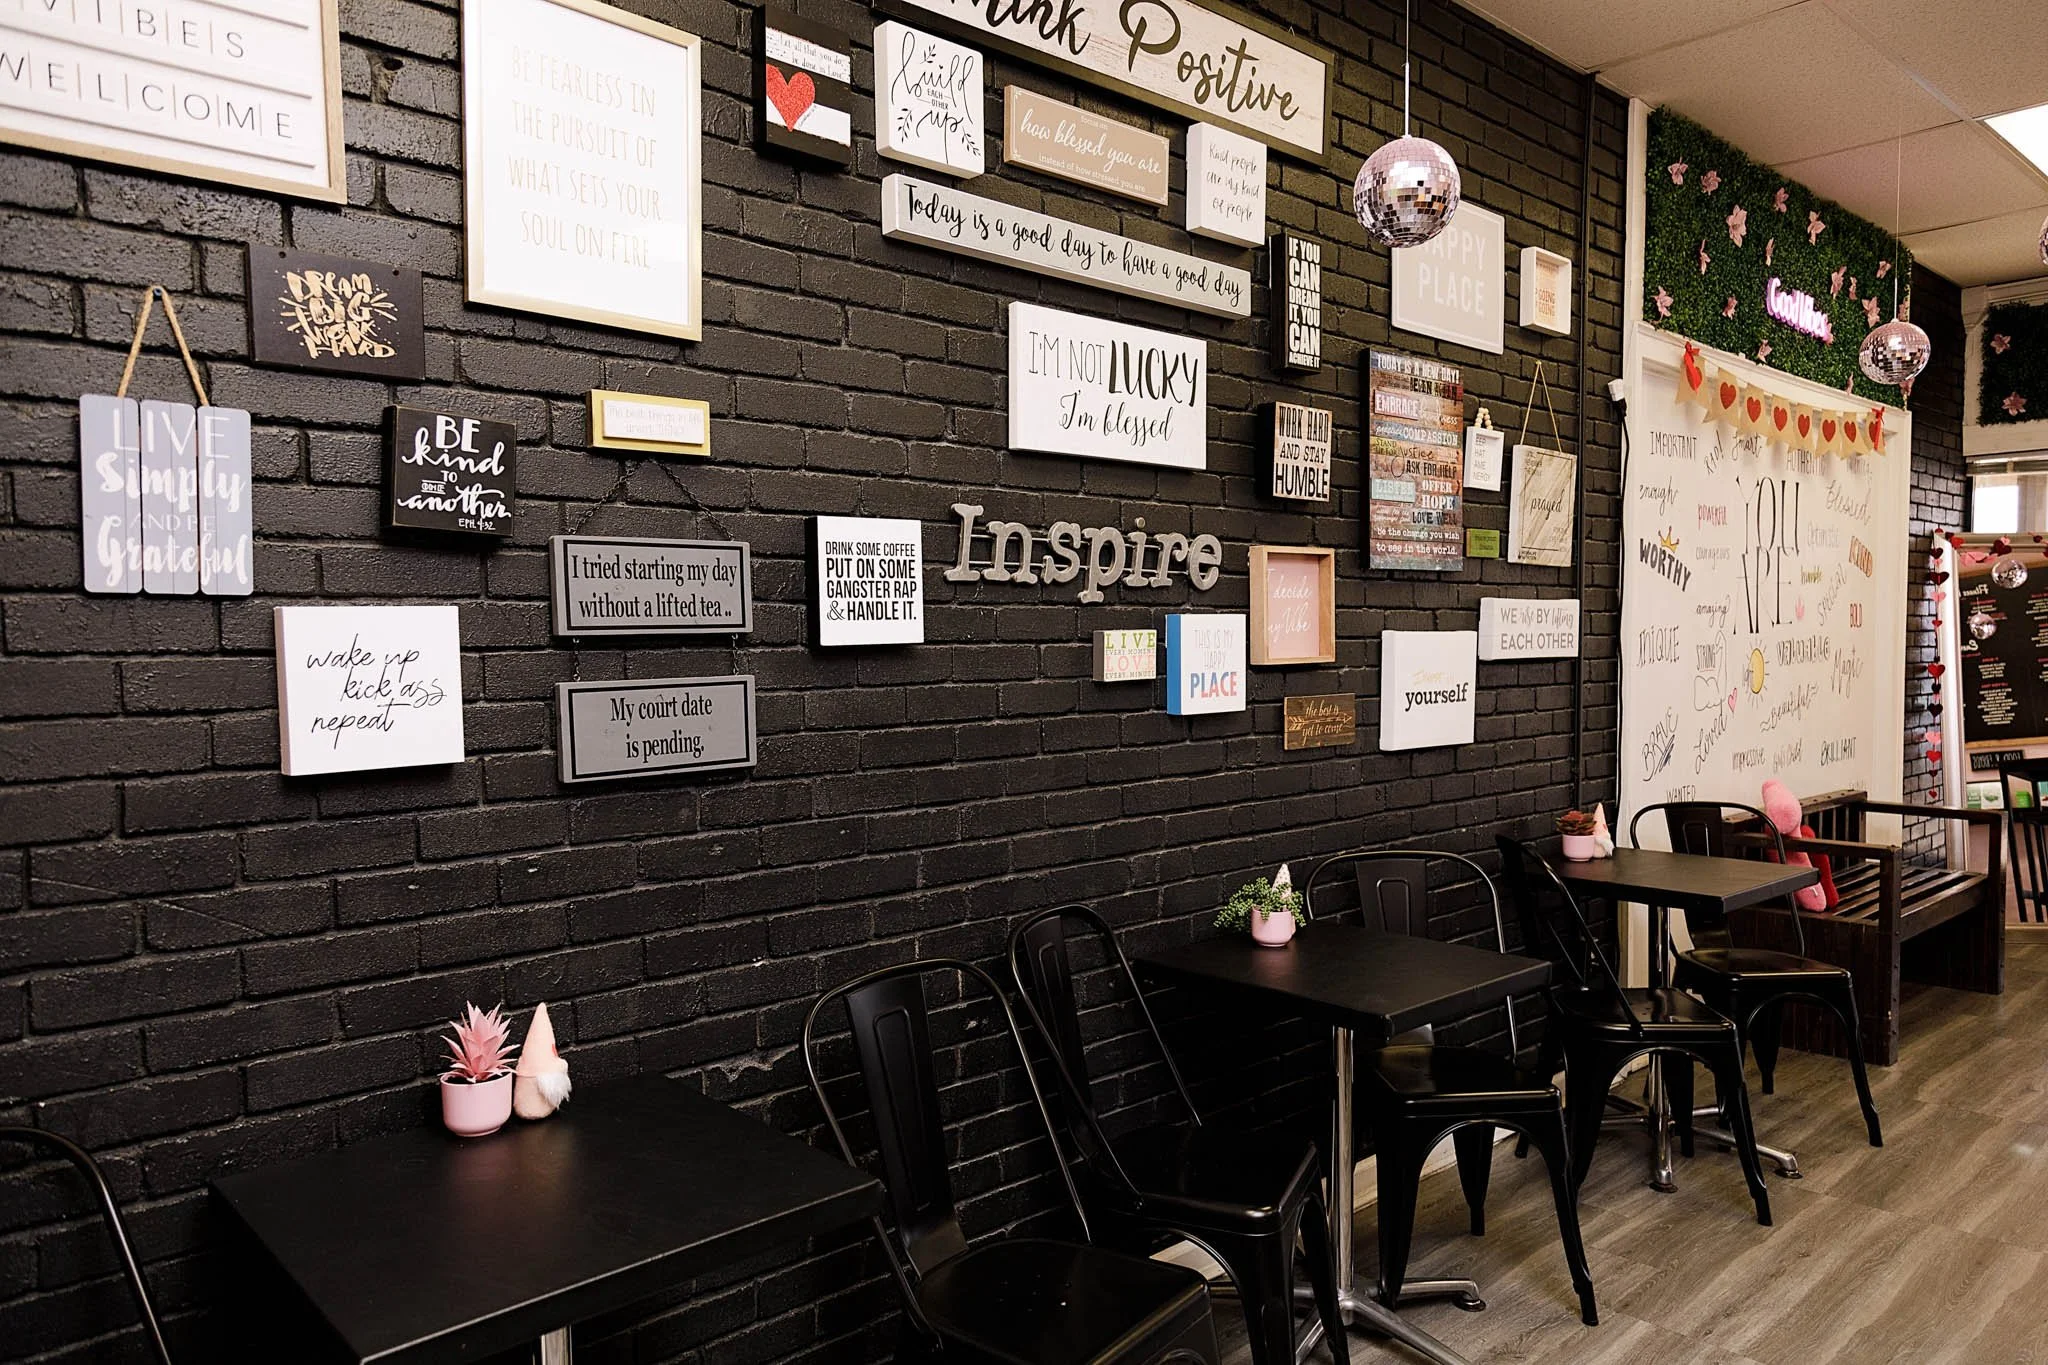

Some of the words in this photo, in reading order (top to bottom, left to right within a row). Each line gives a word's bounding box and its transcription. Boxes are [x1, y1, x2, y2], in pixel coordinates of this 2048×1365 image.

[1119, 0, 1299, 121] Positive
[540, 54, 622, 108] FEARLESS
[631, 82, 656, 117] IN
[891, 31, 975, 125] build
[927, 88, 943, 99] EACH
[931, 98, 949, 110] OTHER
[512, 99, 543, 141] THE
[552, 113, 628, 160] PURSUIT
[636, 135, 656, 168] OF
[915, 110, 964, 164] up
[1021, 108, 1050, 140] how
[1054, 119, 1107, 157] blessed
[1104, 148, 1135, 172] you
[1138, 157, 1161, 174] are
[508, 154, 561, 197] WHAT
[569, 169, 608, 208] SETS
[616, 182, 661, 221] YOUR
[521, 210, 567, 251] SOUL
[575, 223, 603, 258] ON
[612, 231, 651, 269] FIRE
[904, 183, 968, 238] Today
[972, 210, 990, 241] is
[996, 218, 1006, 236] a
[1012, 222, 1055, 252] good
[1061, 235, 1096, 271] day
[1098, 241, 1118, 265] to
[1123, 241, 1158, 276] have
[1162, 262, 1171, 280] a
[1175, 267, 1209, 292] good
[1214, 271, 1244, 307] day
[1289, 237, 1299, 257] IF
[1300, 239, 1320, 264] YOU
[1289, 257, 1320, 292] CAN
[1418, 261, 1485, 316] PLACE
[309, 292, 372, 325] BIG
[1289, 285, 1320, 310] DREAM
[1289, 303, 1300, 324] IT,
[1300, 305, 1320, 327] YOU
[1289, 322, 1320, 357] CAN
[1029, 331, 1061, 379] I'M
[1070, 339, 1105, 385] NOT
[1109, 339, 1198, 407] LUCKY
[1289, 351, 1314, 367] ACHIEVE
[1314, 355, 1320, 368] IT
[1377, 353, 1401, 373] TODAY
[1404, 359, 1412, 374] IS
[1414, 361, 1420, 375] A
[1422, 363, 1440, 380] NEW
[1059, 389, 1098, 430] I'm
[1103, 401, 1174, 447] blessed
[1376, 394, 1418, 417] EMBRACE
[113, 408, 230, 459] LIVE
[436, 415, 481, 453] BE
[1279, 405, 1303, 440] WORK
[1307, 410, 1329, 443] HARD
[1403, 427, 1458, 445] COMPASSION
[402, 427, 505, 476] kind
[1280, 442, 1300, 462] AND
[1303, 446, 1327, 464] STAY
[1650, 431, 1697, 461] IMPORTANT
[96, 452, 245, 512] Simply
[441, 470, 458, 483] TO
[1275, 463, 1329, 499] HUMBLE
[1406, 459, 1420, 475] ASK
[1424, 461, 1437, 477] FOR
[1440, 463, 1457, 479] HELP
[397, 483, 511, 519] another
[1421, 494, 1454, 510] HOPE
[1422, 479, 1452, 494] OFFER
[1639, 476, 1679, 517] enough
[1412, 511, 1433, 524] LOVE
[1530, 488, 1564, 520] prayed
[1736, 476, 1800, 558] YOU
[97, 515, 248, 587] Grateful
[826, 541, 854, 555] DRINK
[856, 542, 881, 556] SOME
[883, 543, 916, 557] COFFEE
[1376, 543, 1386, 552] to
[1404, 544, 1414, 553] in
[1416, 545, 1431, 554] the
[1430, 531, 1443, 540] you
[826, 558, 852, 578] PUT
[857, 558, 875, 578] ON
[879, 559, 916, 579] SOME
[943, 503, 1222, 603] Inspire
[1639, 538, 1692, 592] WORTHY
[1849, 535, 1873, 578] KIND
[571, 555, 580, 578] I
[583, 554, 621, 579] tried
[625, 556, 684, 587] starting
[687, 563, 709, 586] my
[712, 557, 737, 587] day
[578, 592, 640, 618] without
[644, 599, 653, 618] a
[656, 592, 697, 617] lifted
[827, 580, 890, 598] GANGSTER
[894, 581, 917, 598] RAP
[1733, 546, 1793, 635] ARE
[826, 600, 845, 620] &
[847, 601, 899, 621] HANDLE
[903, 601, 917, 620] IT.
[1500, 607, 1518, 624] WE
[1537, 608, 1550, 624] BY
[1696, 594, 1731, 628] amazing
[1105, 632, 1155, 649] LIVE
[1501, 633, 1533, 650] EACH
[1537, 632, 1574, 649] OTHER
[307, 633, 375, 668] wake
[385, 649, 420, 683] up
[1106, 655, 1155, 672] LOVE
[1831, 646, 1864, 700] Magic
[340, 665, 392, 702] kick
[400, 678, 447, 708] ass
[1190, 671, 1237, 699] PLACE
[1405, 682, 1469, 712] yourself
[311, 698, 411, 750] repeat
[610, 697, 635, 726] My
[638, 696, 678, 720] court
[681, 692, 713, 717] date
[626, 733, 639, 759] is
[642, 729, 705, 763] pending.
[1642, 706, 1679, 781] BRAVE
[1694, 698, 1728, 775] Loved
[1821, 737, 1857, 767] BRILLIANT
[1666, 784, 1697, 803] WANTED
